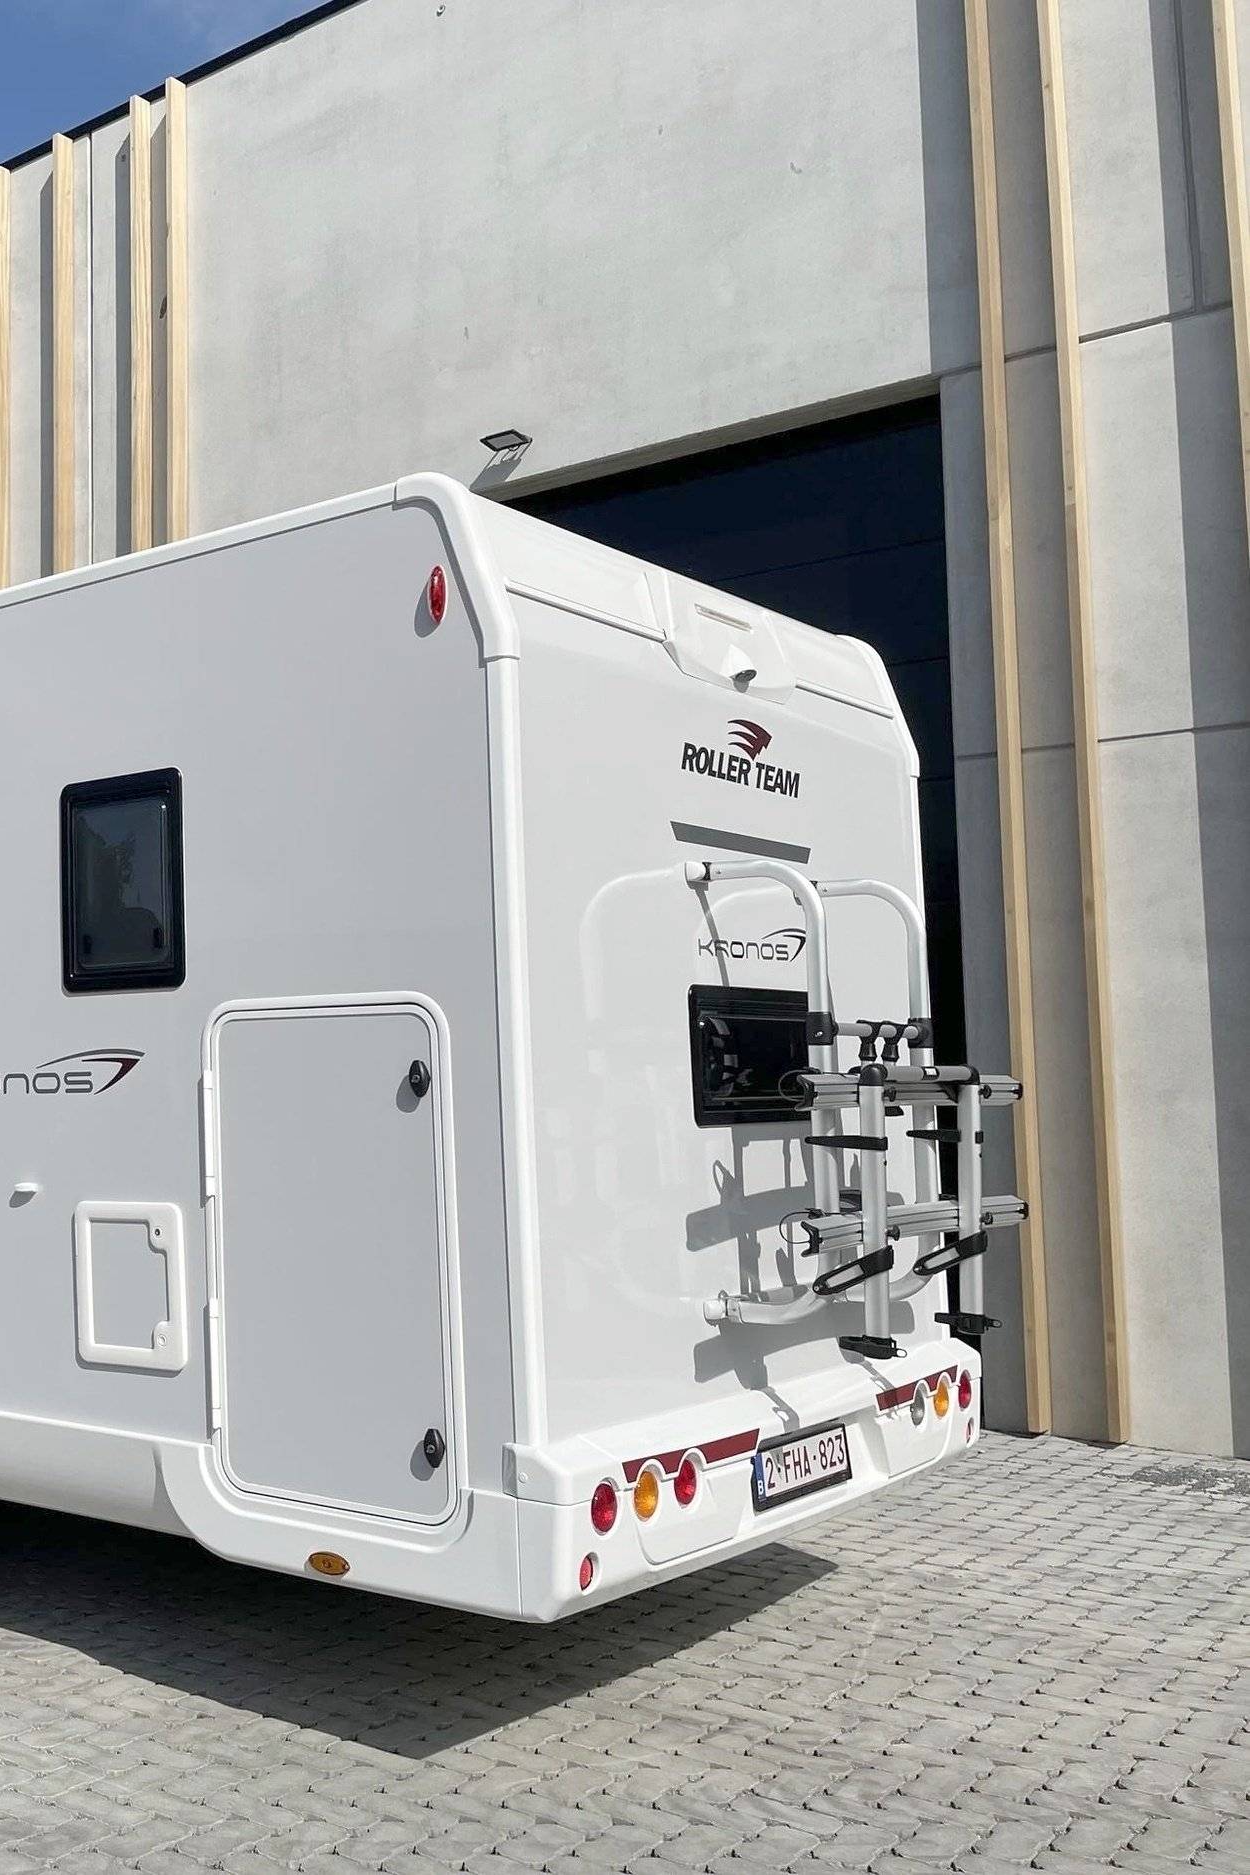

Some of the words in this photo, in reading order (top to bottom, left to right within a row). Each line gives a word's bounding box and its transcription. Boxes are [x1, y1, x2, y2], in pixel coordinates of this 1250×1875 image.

[681, 742, 750, 786] ROLLER
[755, 761, 800, 798] TEAM
[698, 938, 789, 961] KRONOS
[758, 1480, 765, 1496] B
